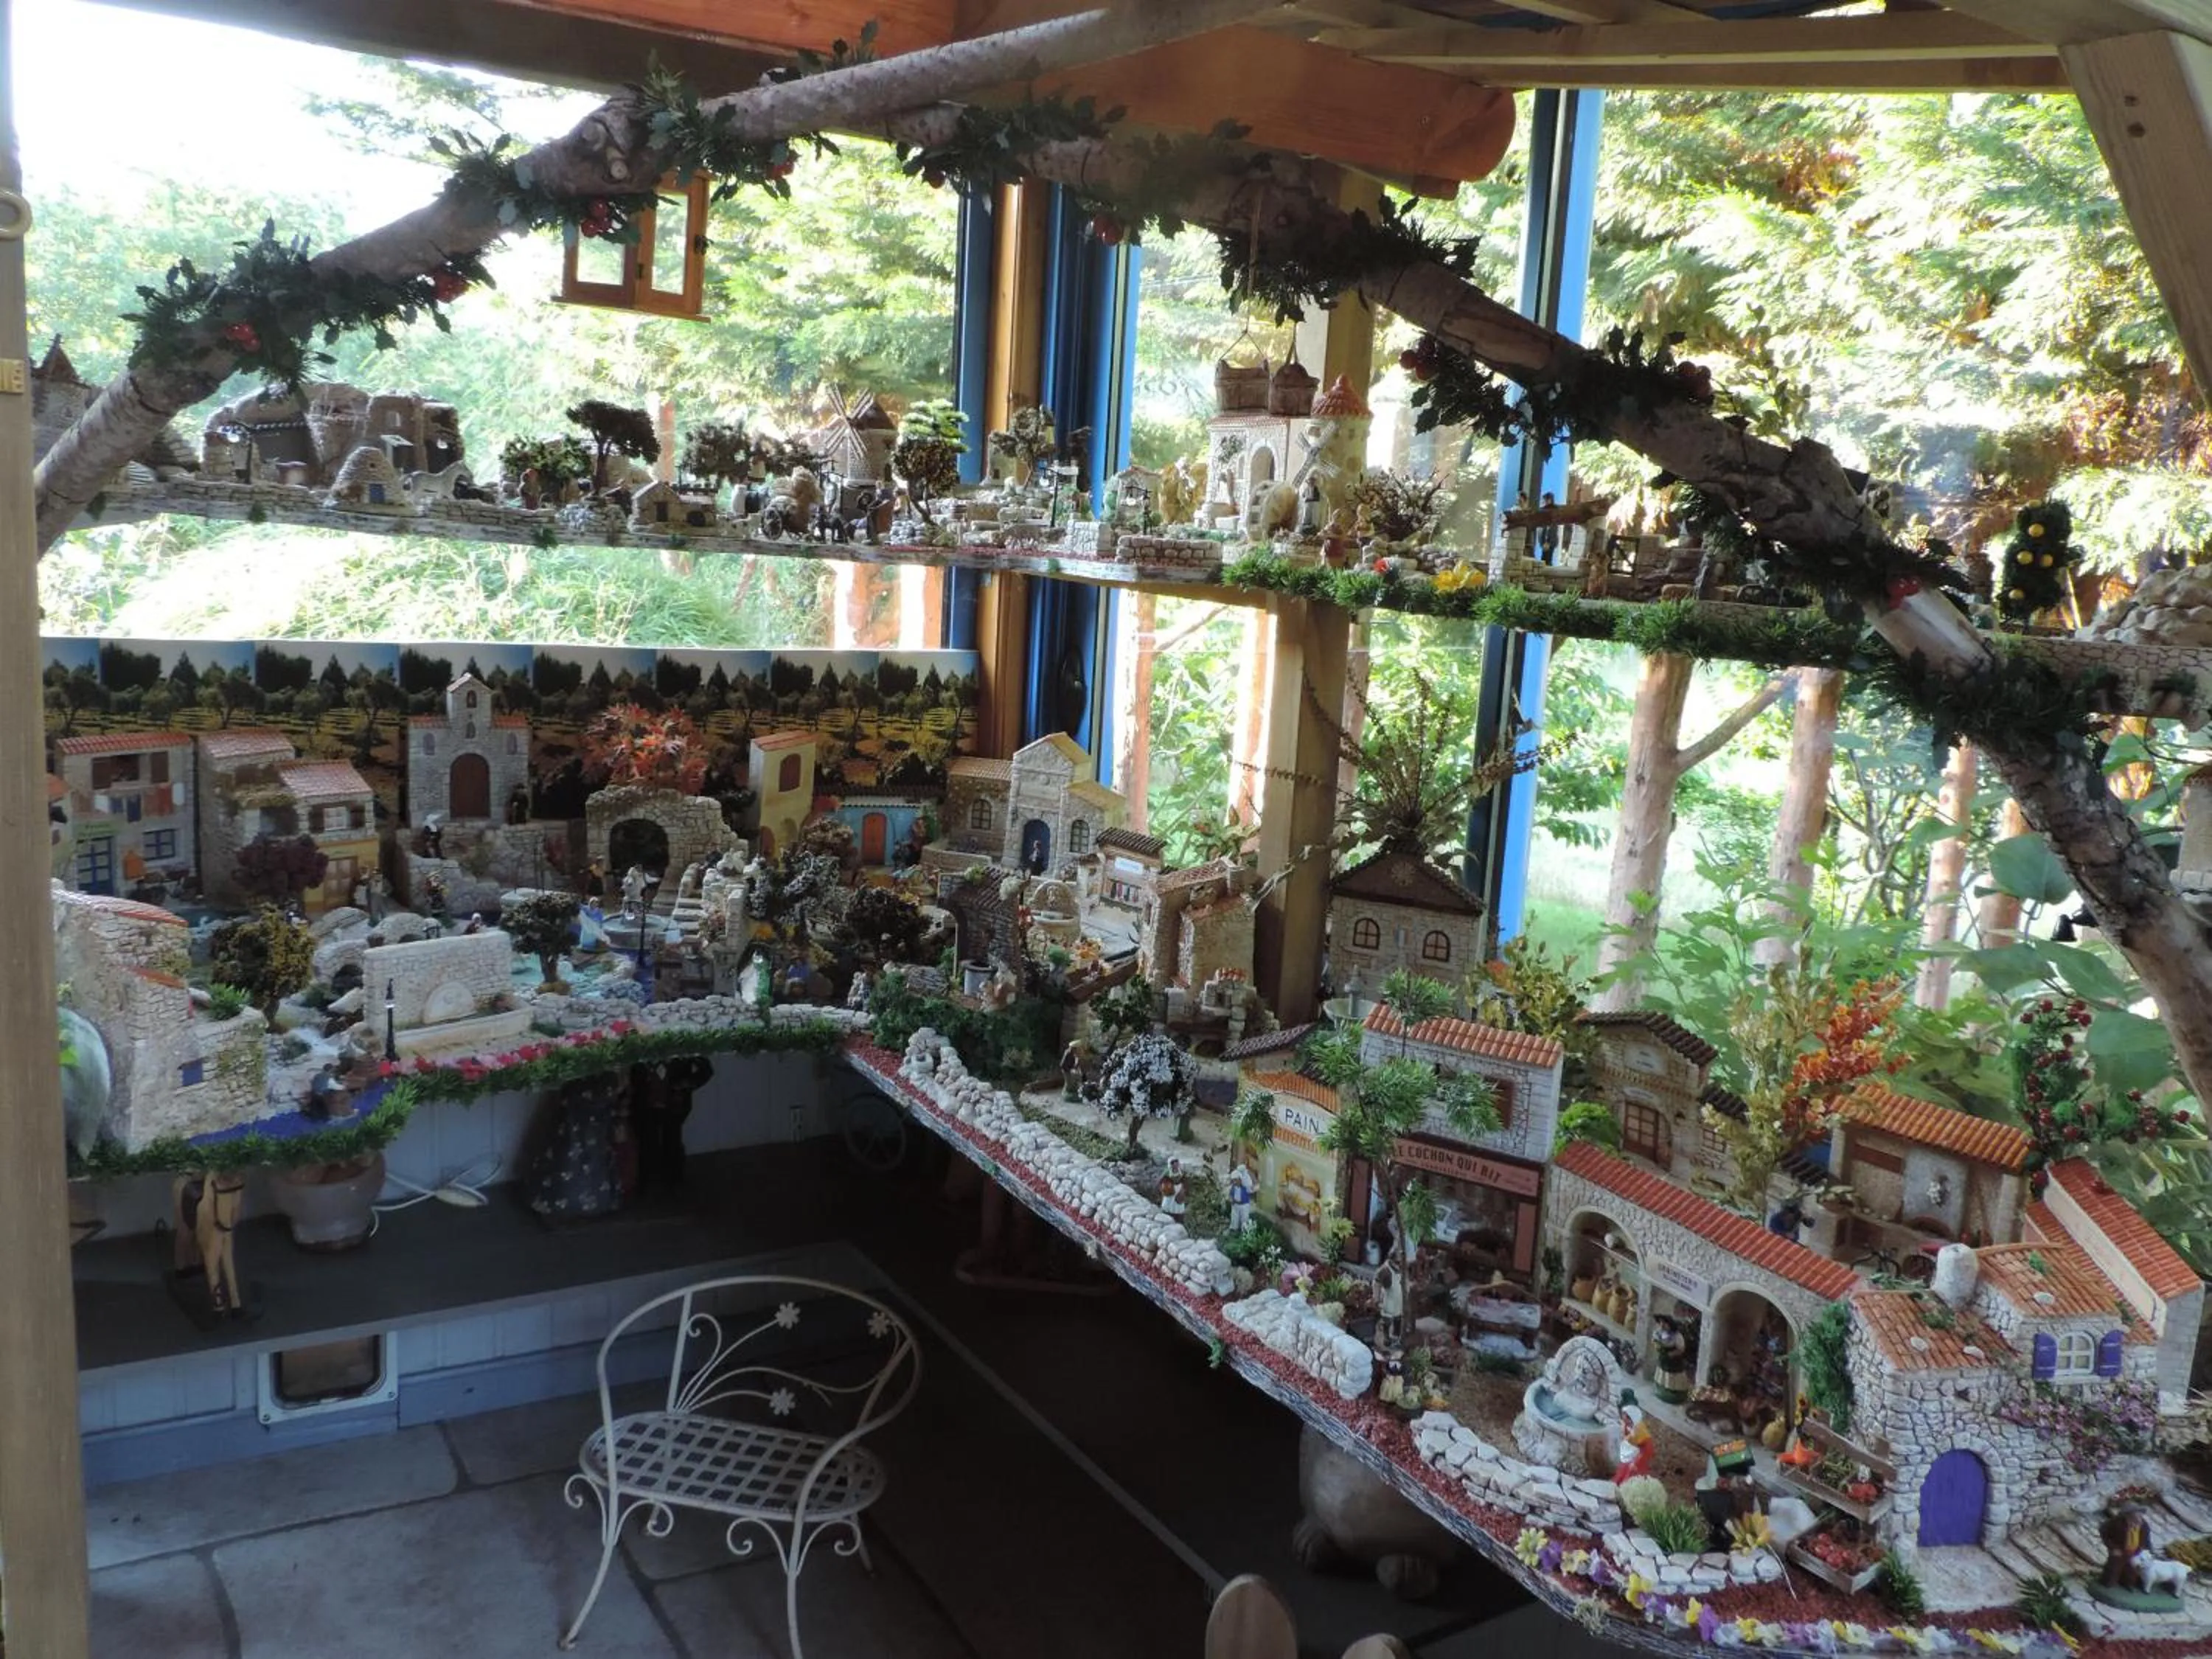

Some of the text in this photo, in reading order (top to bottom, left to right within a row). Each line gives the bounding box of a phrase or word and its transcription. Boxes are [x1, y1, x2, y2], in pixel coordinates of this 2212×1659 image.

[1284, 1107, 1320, 1134] PAIN
[1408, 1145, 1453, 1165] COCHON
[1457, 1155, 1478, 1173] QUI
[1480, 1164, 1503, 1183] RIT
